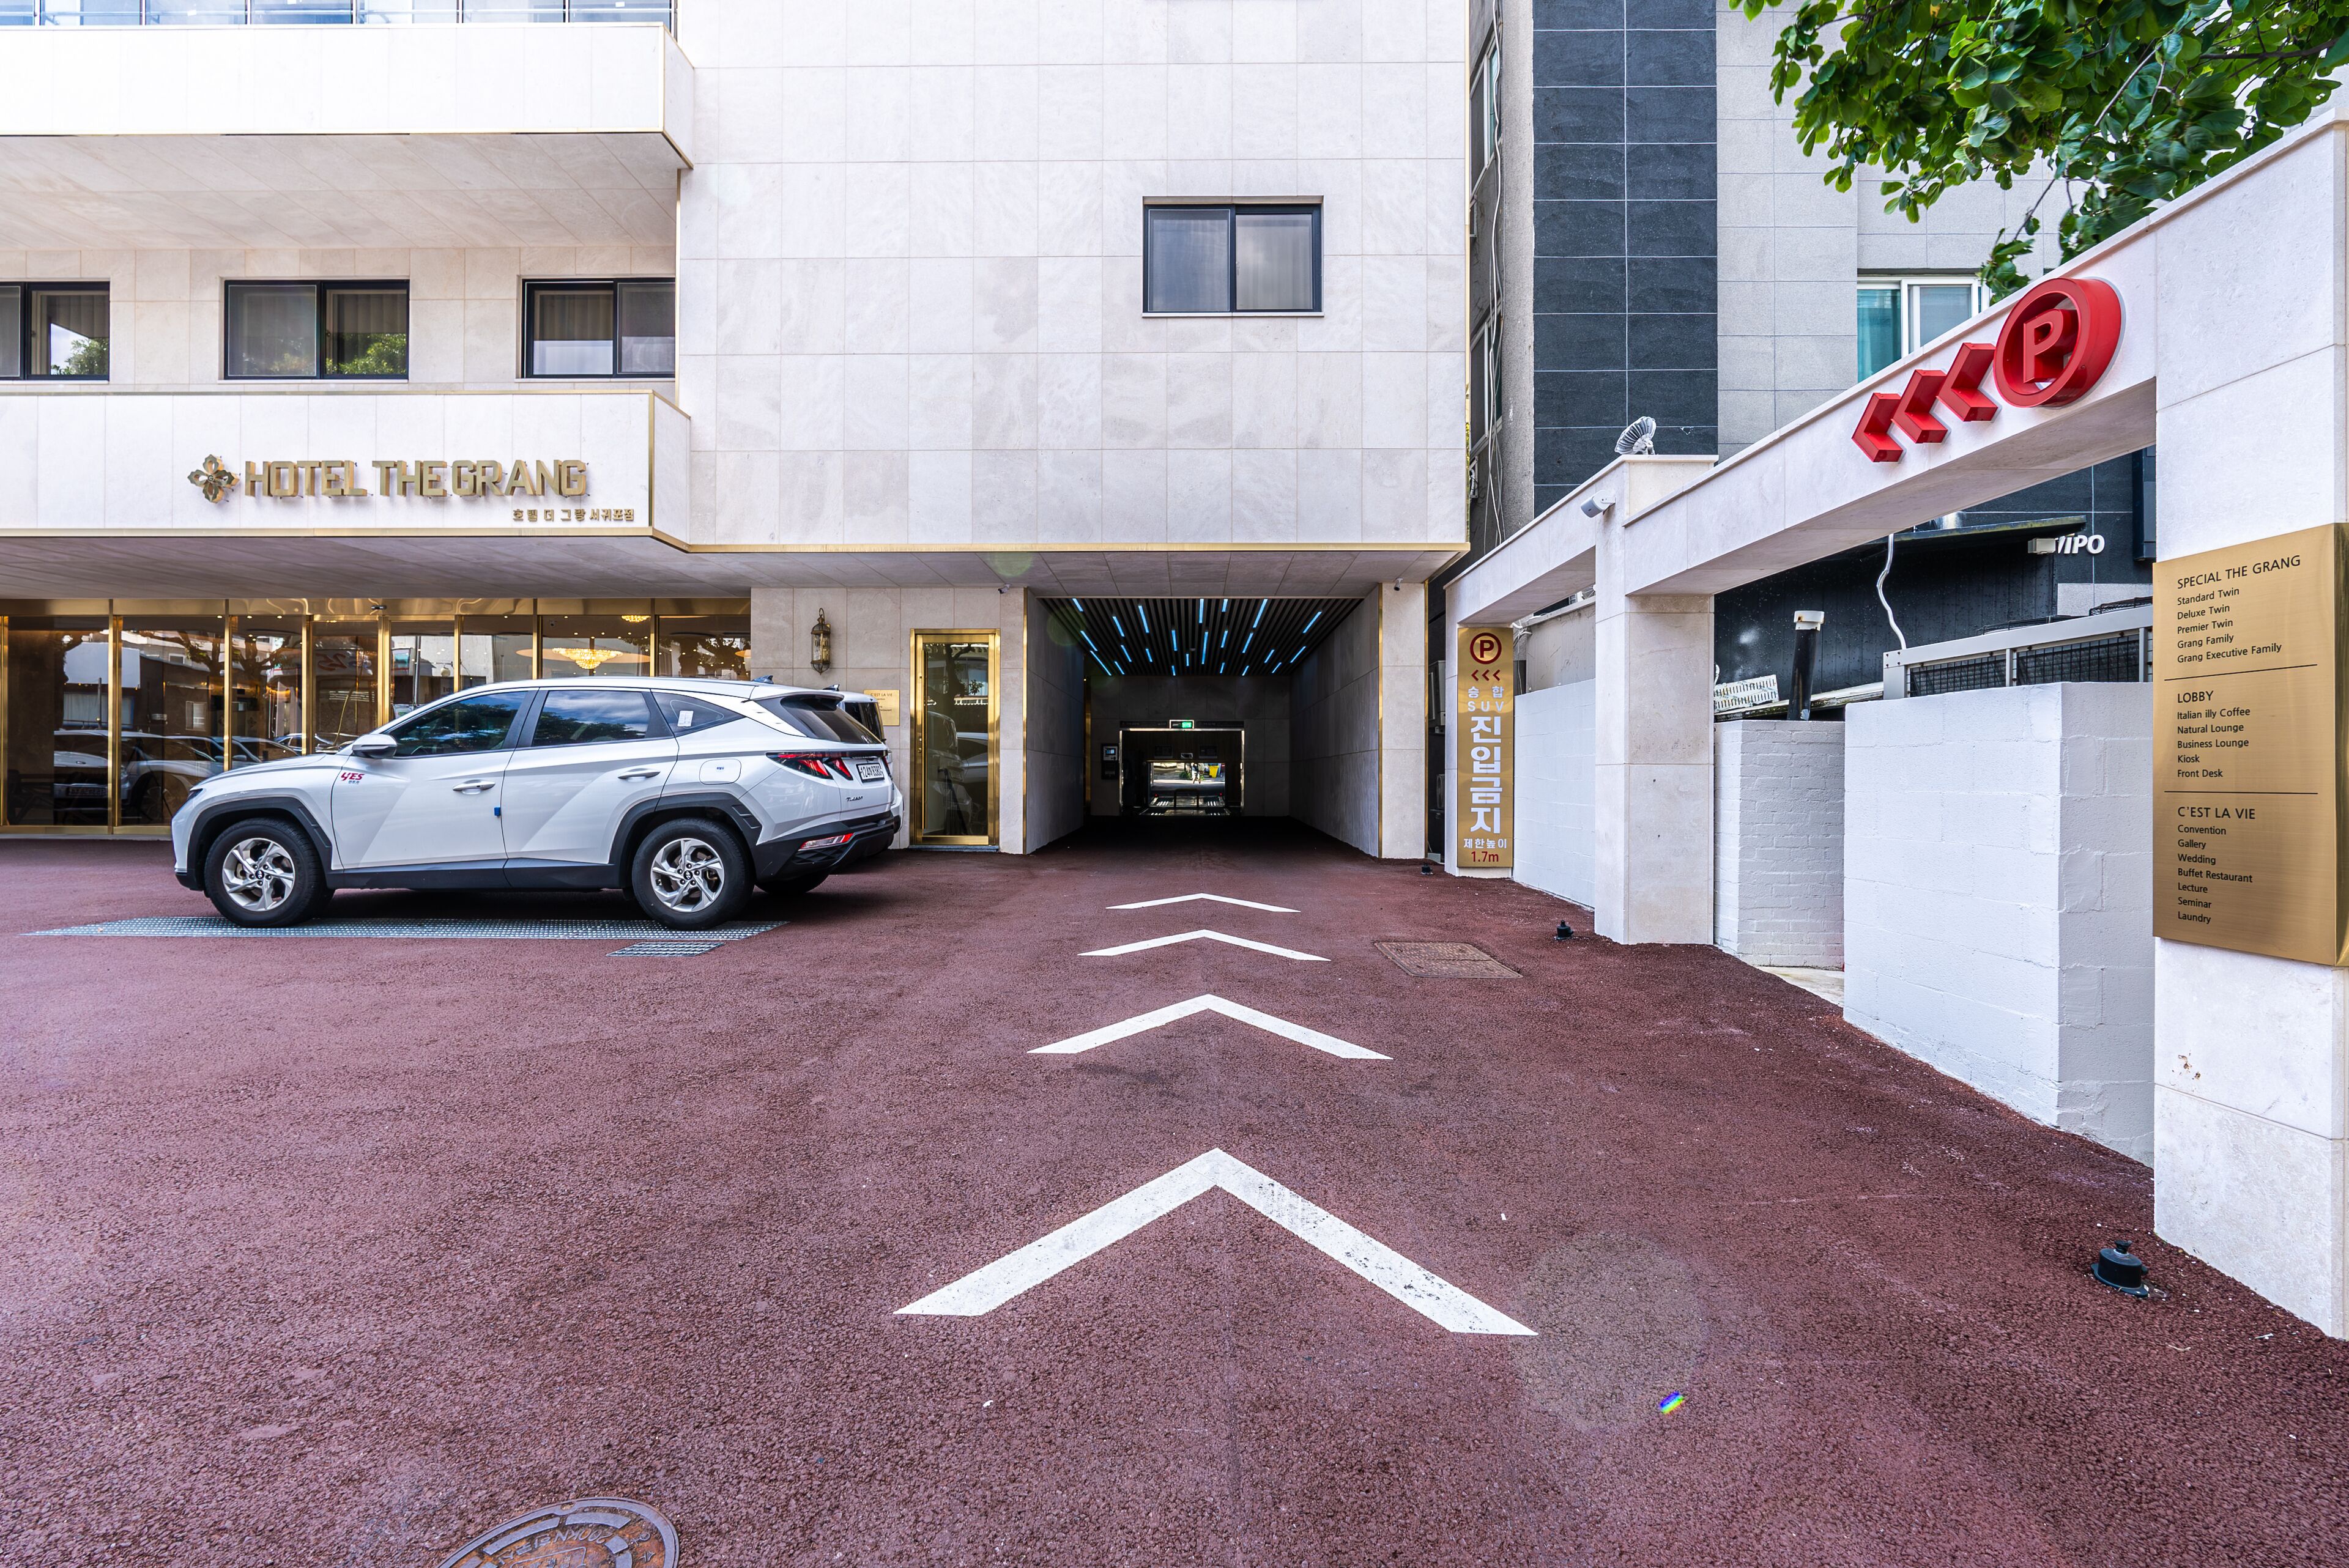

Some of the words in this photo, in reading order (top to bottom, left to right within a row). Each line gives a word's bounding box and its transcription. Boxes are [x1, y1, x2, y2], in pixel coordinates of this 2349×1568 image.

[245, 460, 368, 497] HOTEL
[372, 460, 448, 497] THE
[451, 459, 587, 497] GRANG
[513, 508, 538, 522] 호텔
[544, 508, 555, 522] 더
[560, 508, 587, 522] 그랑
[590, 508, 634, 522] 서귀포점
[2177, 571, 2222, 589] SPECIAL
[2225, 565, 2247, 579] THE
[2252, 555, 2301, 574] GRANG
[2177, 591, 2214, 606] Standard
[2217, 587, 2240, 598] Twin
[2177, 610, 2206, 620] Deluxe
[2208, 604, 2230, 615] Twin
[2177, 623, 2209, 634] Premier
[2211, 618, 2233, 629] Twin
[2177, 640, 2203, 649] Grang
[2206, 633, 2234, 645] Family
[2177, 654, 2203, 663] Grang
[2206, 648, 2248, 660] Executive
[2251, 642, 2282, 654] Family
[2177, 690, 2214, 703] LOBBY
[2177, 710, 2202, 720] Italian
[2205, 709, 2217, 719] illy
[2219, 707, 2251, 717] Coffee
[2177, 724, 2208, 734] Natural
[2211, 724, 2244, 733] Lounge
[2177, 739, 2213, 749] Business
[2216, 739, 2249, 749] Lounge
[2177, 754, 2200, 763] Kiosk
[341, 772, 365, 782] YES
[1469, 715, 1503, 834] 진입금지
[2177, 769, 2200, 778] Front
[2202, 768, 2224, 778] Desk
[2177, 806, 2211, 818] C'EST
[2215, 807, 2231, 819] LA
[2235, 808, 2255, 819] VIE
[2177, 824, 2227, 835] Convention
[1463, 837, 1508, 850] 제한높이
[2178, 838, 2206, 850] Gallery
[1471, 851, 1499, 863] 1.7m
[2177, 853, 2216, 866] Wedding
[2178, 868, 2203, 878] Buffet
[2206, 870, 2253, 883] Restaurant
[2178, 882, 2208, 893] Lecture
[2178, 897, 2212, 909] Seminar
[2178, 911, 2211, 925] Laundry
